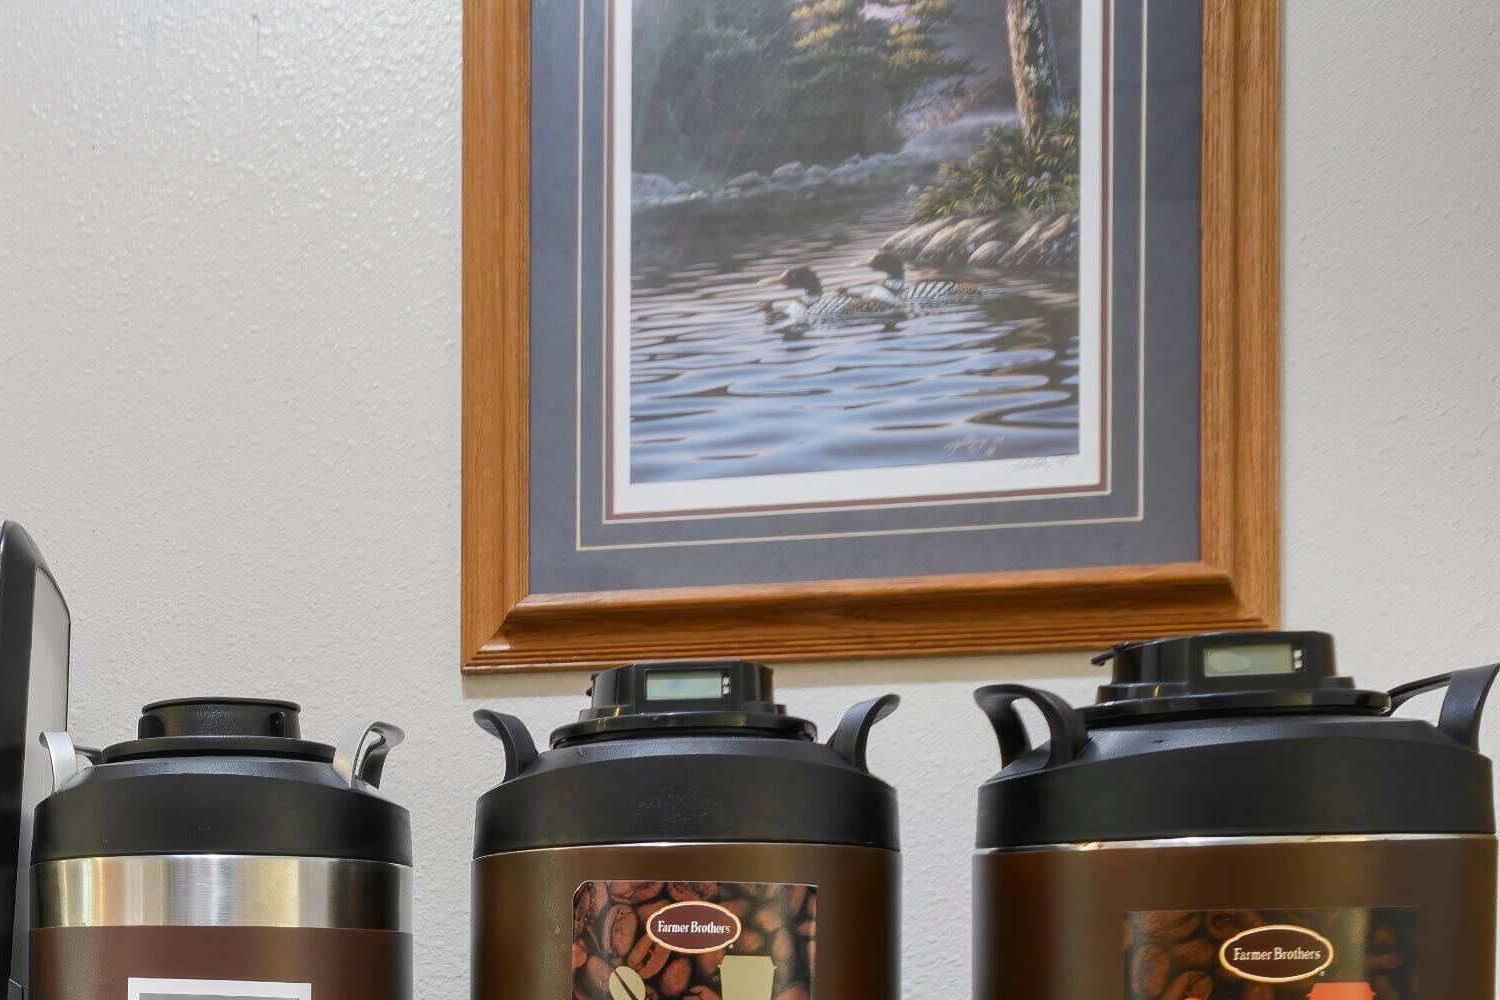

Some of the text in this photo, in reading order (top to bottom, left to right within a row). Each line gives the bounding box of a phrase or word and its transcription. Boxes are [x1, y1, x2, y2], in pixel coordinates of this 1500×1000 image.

[658, 920, 731, 935] Farmer Brothers
[1233, 947, 1321, 961] Farmer Brothers
